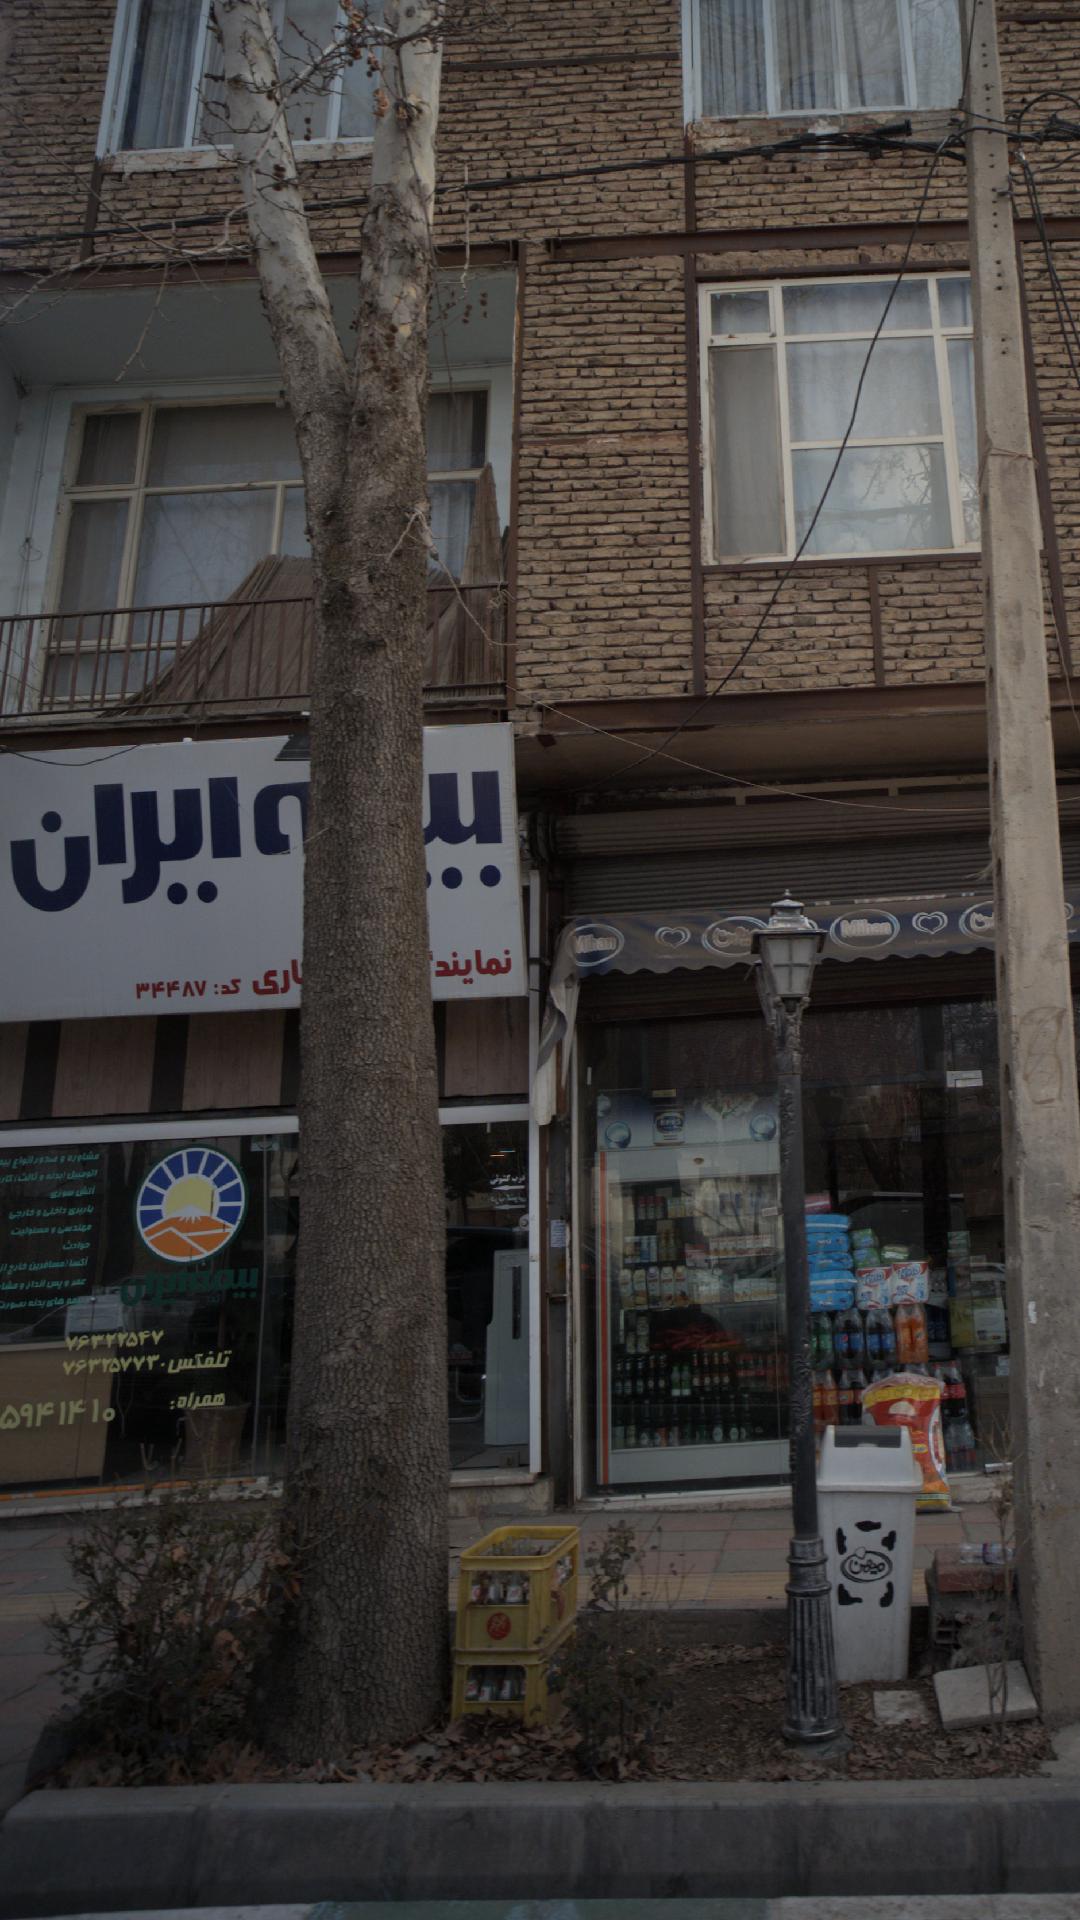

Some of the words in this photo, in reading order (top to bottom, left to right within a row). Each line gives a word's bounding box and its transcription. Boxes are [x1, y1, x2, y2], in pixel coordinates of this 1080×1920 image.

[10, 776, 242, 912] ایران
[840, 918, 893, 938] Mihan
[427, 949, 512, 985] نمایند
[213, 979, 241, 995] کد:
[252, 959, 304, 996] اری
[136, 980, 207, 999] ۳۴۴۸۷
[849, 1558, 886, 1575] میهن
